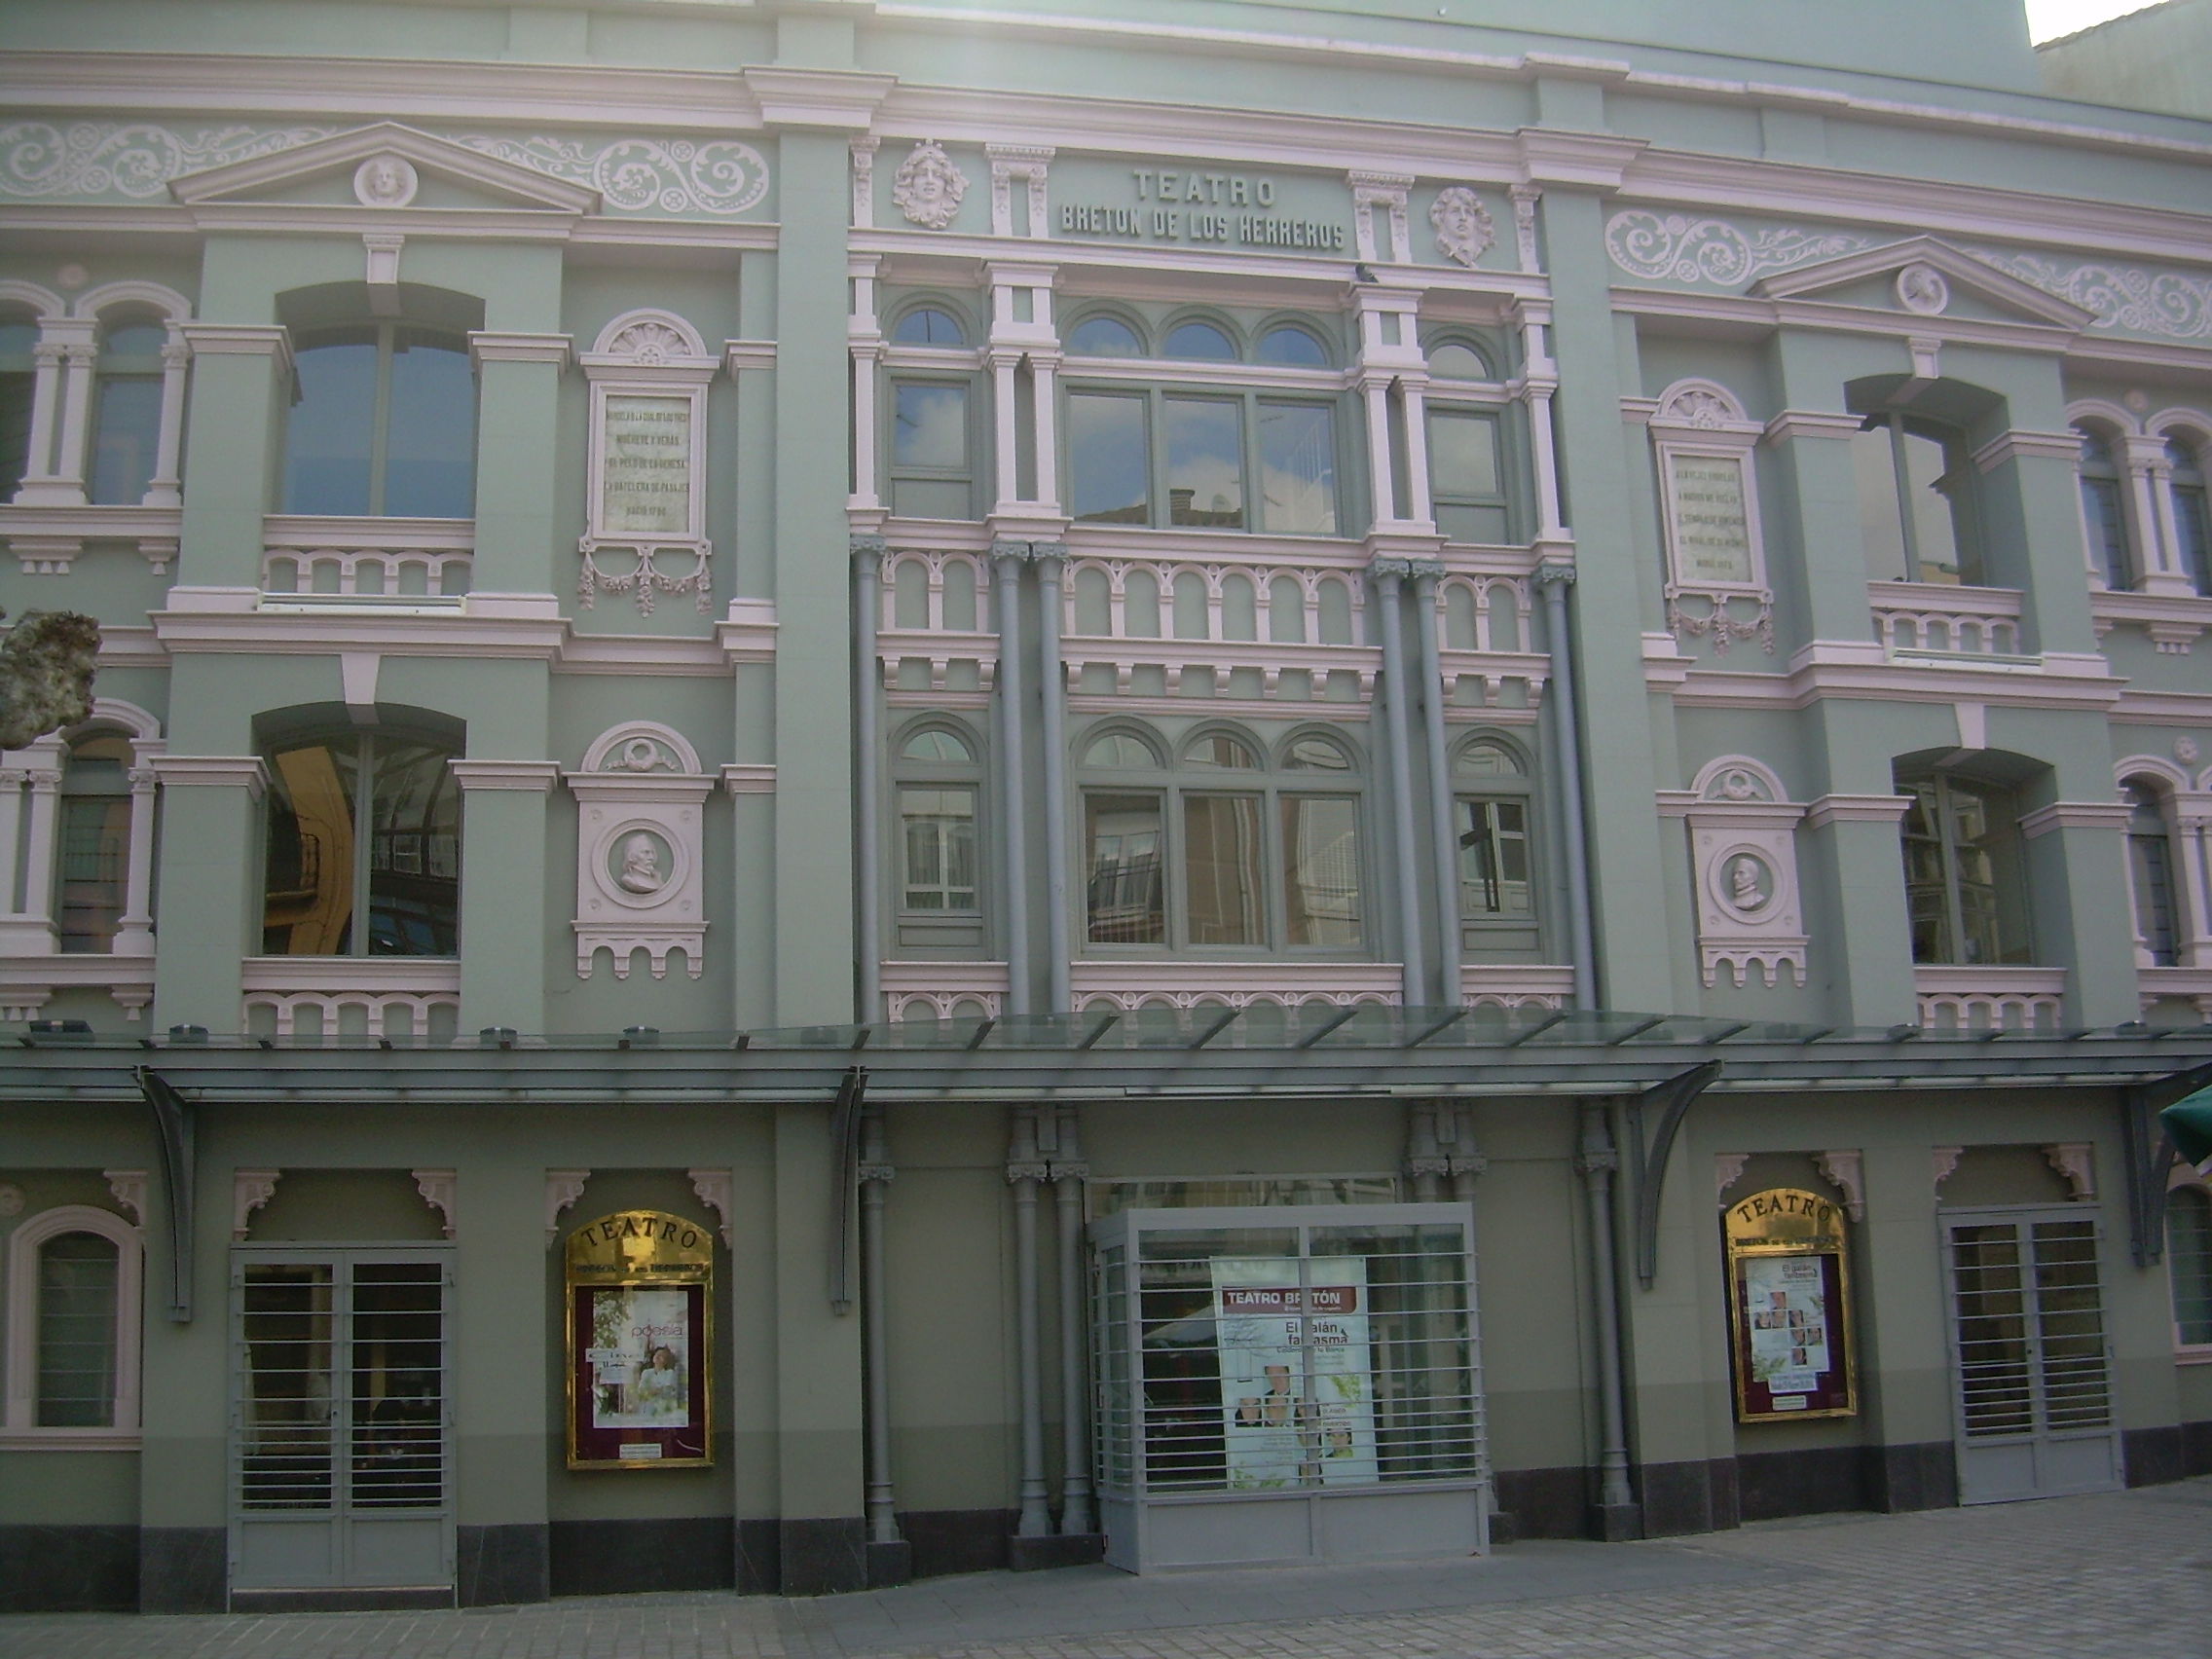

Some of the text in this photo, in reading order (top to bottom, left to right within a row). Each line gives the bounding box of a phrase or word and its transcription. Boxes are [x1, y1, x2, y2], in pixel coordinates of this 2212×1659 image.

[1132, 168, 1275, 206] TEATRO
[1061, 203, 1346, 251] BRETON DE LOS HERREROS
[1736, 1195, 1830, 1223] TEATRO
[581, 1216, 697, 1248] TEATRO
[1228, 1290, 1341, 1305] TEATRO BRTÓN
[1286, 1321, 1338, 1334] El alán
[1288, 1334, 1348, 1346] faasma
